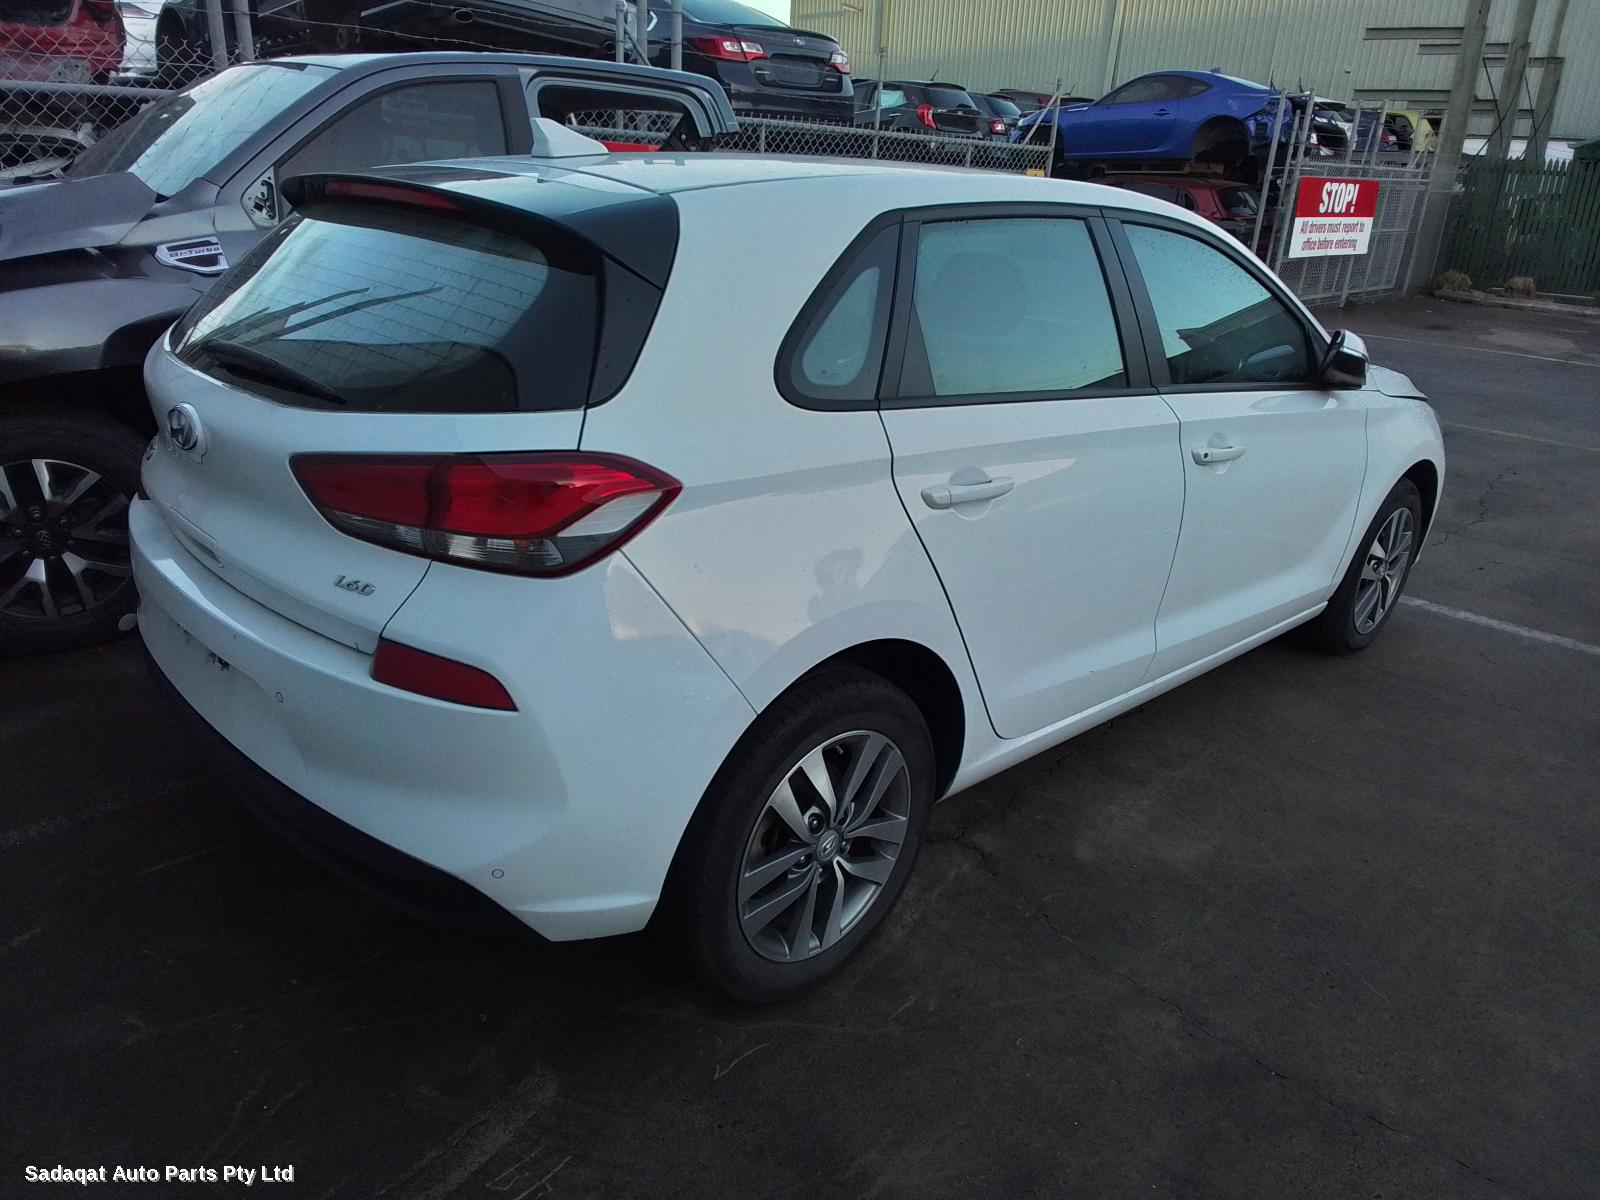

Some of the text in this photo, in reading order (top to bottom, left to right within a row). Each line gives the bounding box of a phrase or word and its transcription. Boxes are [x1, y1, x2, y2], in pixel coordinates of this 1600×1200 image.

[1318, 181, 1360, 214] STOP!
[1300, 219, 1366, 236] All drivers must report to
[1301, 236, 1358, 251] office before entering
